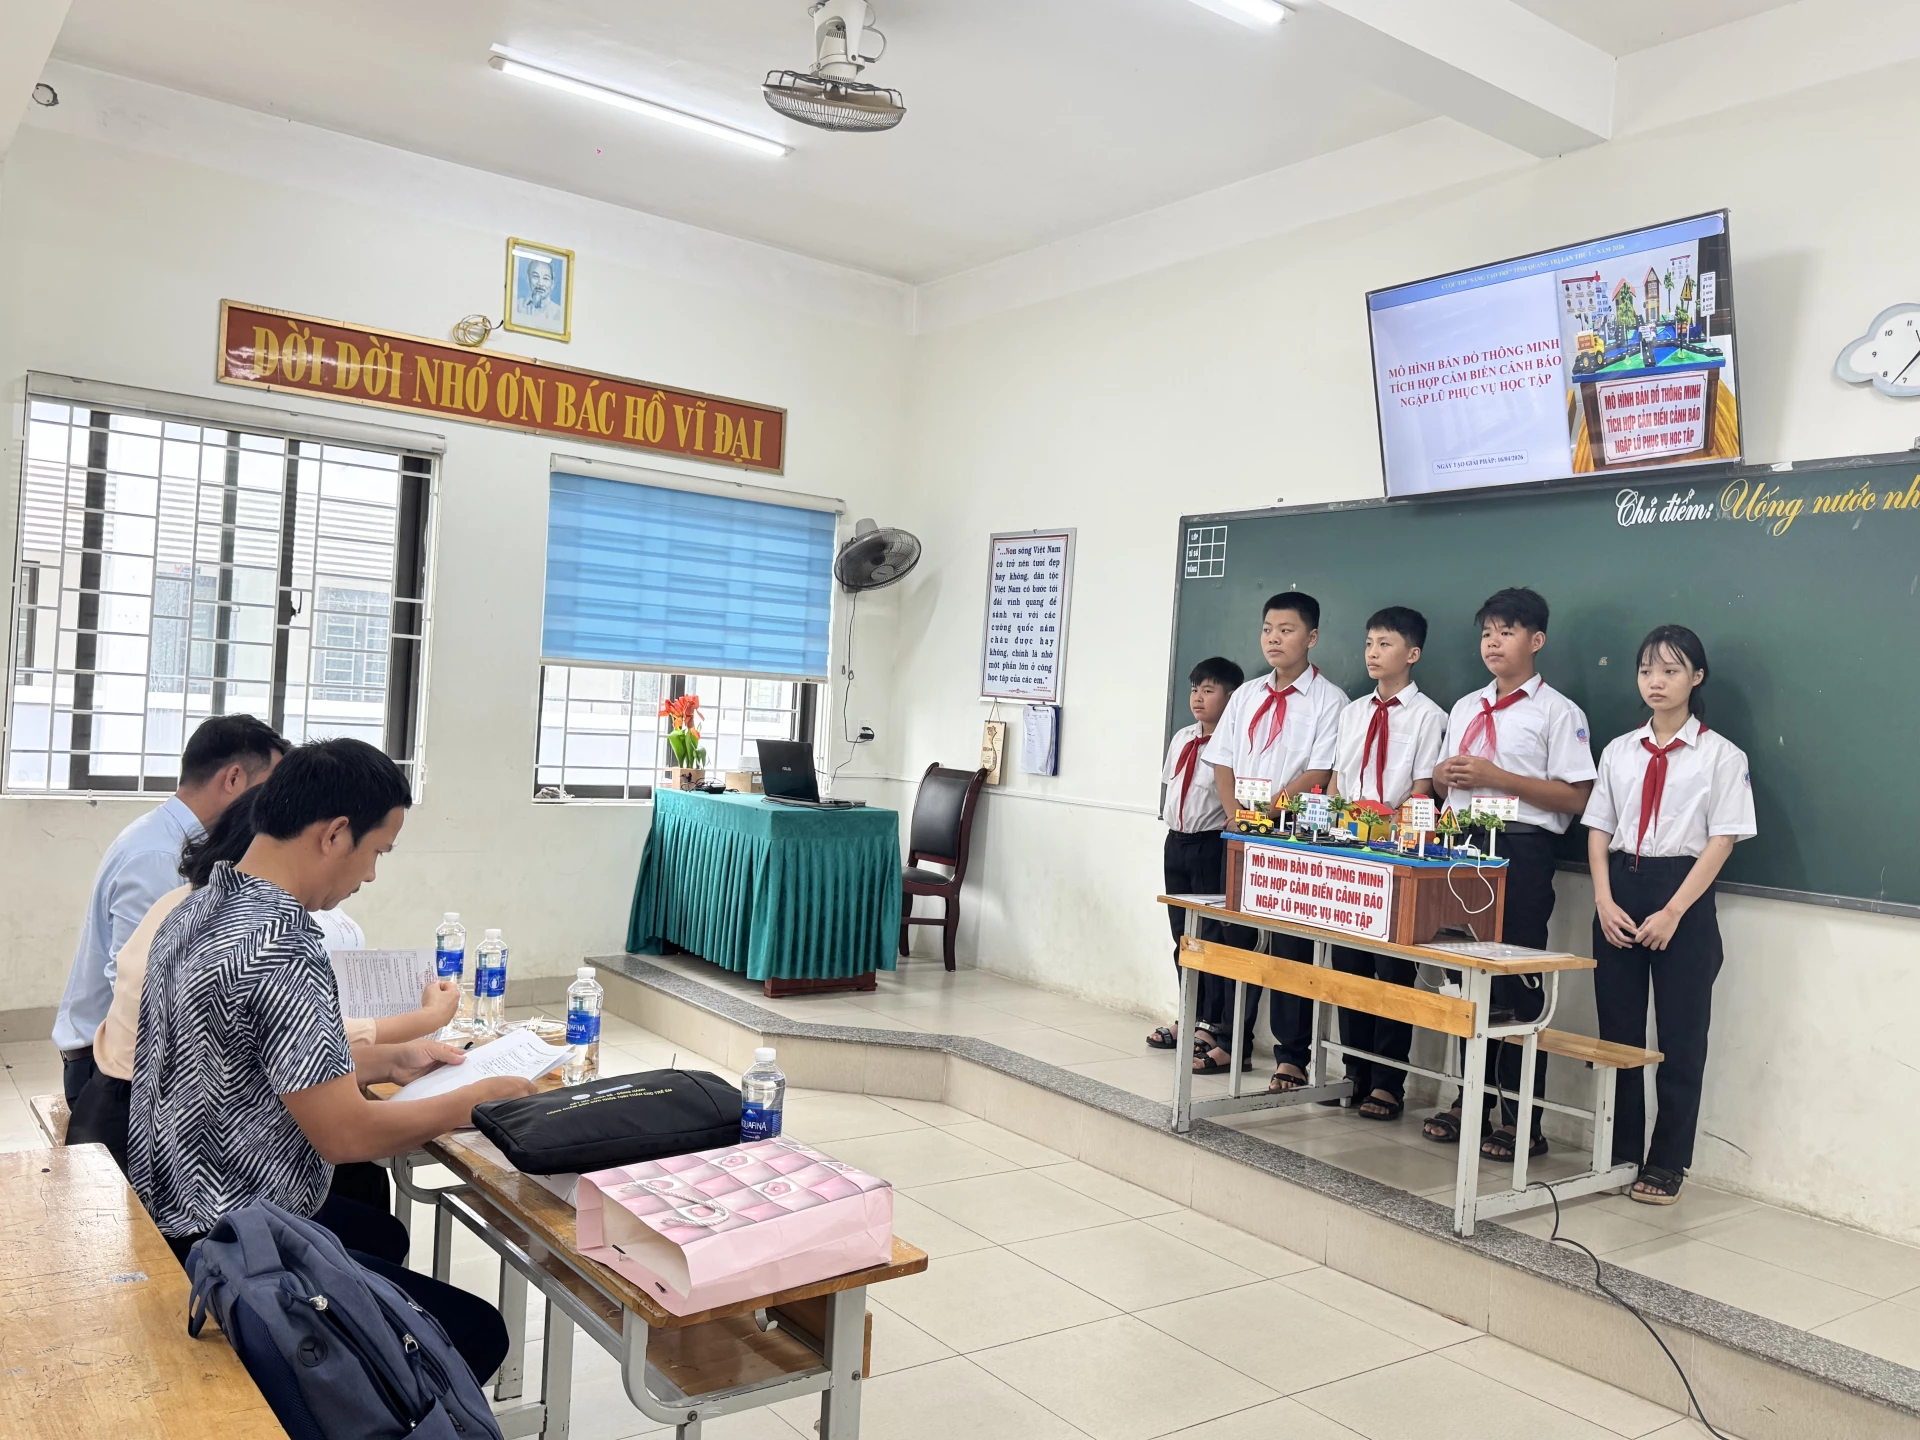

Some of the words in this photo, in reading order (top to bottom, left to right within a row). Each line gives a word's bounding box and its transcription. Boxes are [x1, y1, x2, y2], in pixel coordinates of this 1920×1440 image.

[1388, 364, 1406, 379] MÔ
[1408, 361, 1435, 376] HÌNH
[1438, 356, 1460, 370] BẢN
[1481, 345, 1524, 362] THÔNG
[1526, 338, 1560, 354] MINH
[1388, 380, 1415, 394] TÍCH
[1417, 376, 1440, 390] HỢP
[1441, 371, 1467, 385] CẢM
[1499, 360, 1533, 375] CẢNH
[1536, 354, 1562, 369] BÁO
[1400, 393, 1429, 408] NGẬP
[1431, 389, 1445, 402] LŨ
[1448, 386, 1479, 400] PHỤC
[1481, 383, 1497, 395] VỤ
[1499, 378, 1526, 392] HỌC
[1527, 373, 1552, 388] TẬP
[1604, 391, 1616, 410] MÔ
[1617, 390, 1634, 409] HÌNH
[1635, 385, 1650, 407] BẢN
[1661, 384, 1683, 403] THÔNG
[1683, 383, 1701, 400] MINH
[412, 355, 492, 414] NHỚ
[496, 366, 546, 423] ƠN
[553, 379, 616, 435] BÁC
[623, 390, 667, 444] HỒ
[673, 401, 707, 451] VĨ
[712, 412, 764, 463] ĐẠI
[1606, 415, 1622, 433] TÍCH
[1622, 412, 1636, 433] HỢP
[1637, 408, 1653, 428] CẢM
[1653, 406, 1668, 426] BIẾN
[1669, 404, 1687, 424] CẢNH
[1687, 404, 1701, 422] BÁO
[1614, 436, 1632, 455] NGẬP
[1633, 433, 1642, 450] LŨ
[1642, 434, 1659, 450] PHỤC
[1659, 432, 1669, 449] VỤ
[1669, 430, 1682, 447] HỌC
[1682, 427, 1695, 445] TẬP
[1615, 488, 1657, 527] Chủ
[1659, 488, 1714, 523] điểm:
[1720, 478, 1804, 536] Uống
[1812, 480, 1876, 514] nước
[1017, 546, 1032, 556] sông
[1033, 545, 1046, 555] Việt
[1047, 545, 1061, 553] Nam
[1251, 852, 1265, 868] MÔ
[1267, 854, 1288, 872] HÌNH
[1290, 856, 1309, 875] BẢN
[1325, 864, 1356, 884] THÔNG
[1357, 871, 1384, 888] MINH
[1250, 871, 1268, 888] TÍCH
[1269, 876, 1288, 893] HỢP
[1289, 877, 1310, 896] CẢM
[1311, 881, 1334, 900] BIẾN
[1335, 885, 1361, 906] CẢNH
[1363, 891, 1383, 910] BÁO
[1255, 893, 1279, 912] NGẬP
[1280, 897, 1292, 913] LŨ
[1293, 902, 1318, 919] PHỤC
[1319, 905, 1331, 924] VỤ
[1333, 909, 1353, 926] HỌC
[1354, 911, 1373, 931] TẬP
[741, 1118, 767, 1131] QUAFINA
